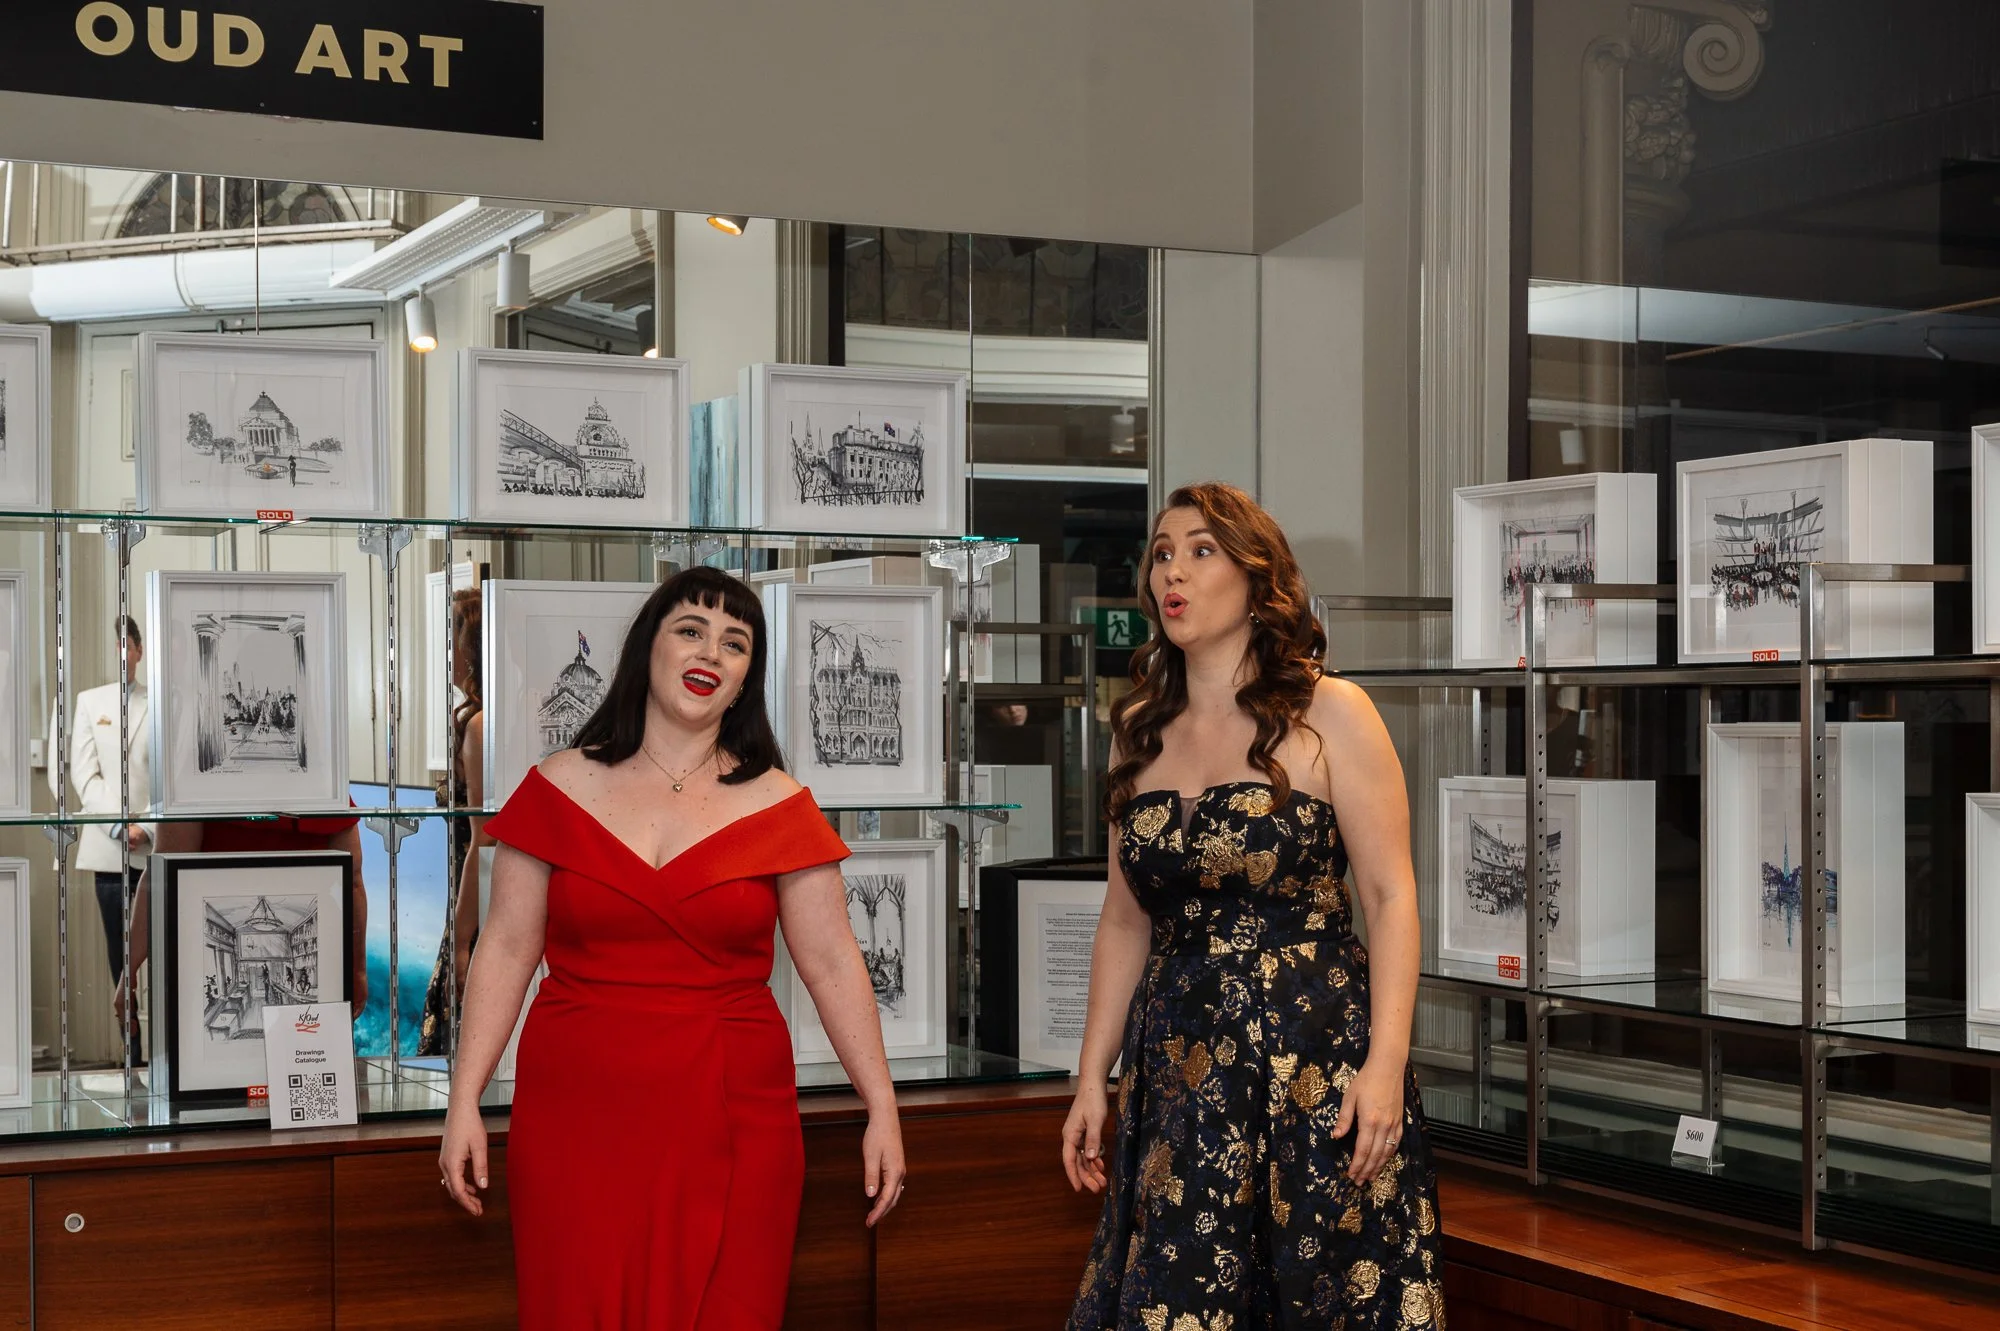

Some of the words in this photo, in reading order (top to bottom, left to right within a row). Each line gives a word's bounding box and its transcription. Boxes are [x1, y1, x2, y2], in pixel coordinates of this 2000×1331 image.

[75, 1, 265, 68] OUD
[294, 24, 464, 88] ART
[259, 511, 292, 520] SOLD
[1753, 651, 1778, 662] SOLD
[1499, 957, 1520, 967] SOLD
[249, 1087, 268, 1096] SO
[1685, 1129, 1704, 1142] $600
